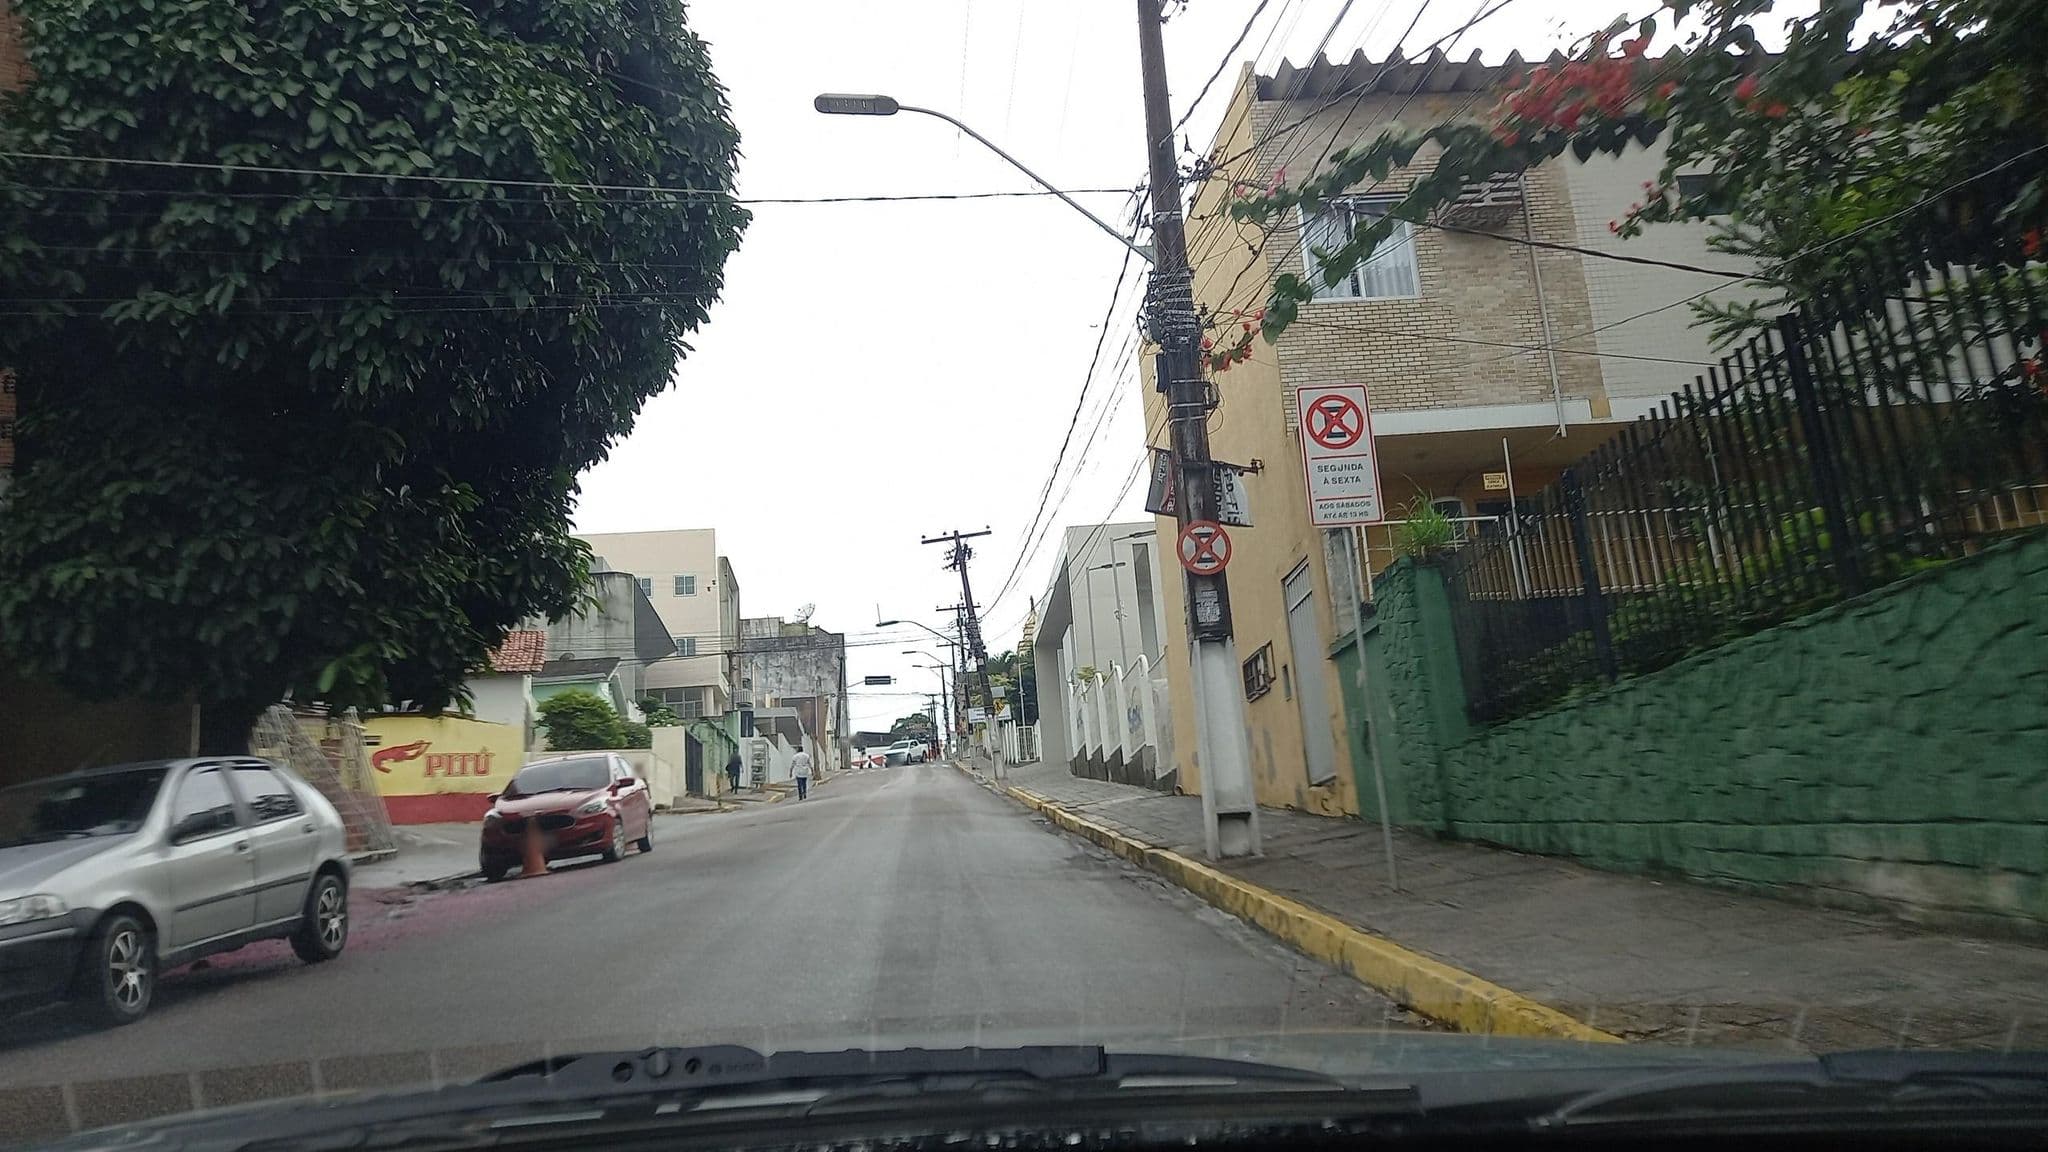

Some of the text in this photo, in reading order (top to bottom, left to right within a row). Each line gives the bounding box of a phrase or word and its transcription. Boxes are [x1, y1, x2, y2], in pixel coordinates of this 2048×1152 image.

[1318, 464, 1364, 472] SEGUNDA
[1332, 476, 1360, 484] SEXTA
[423, 745, 494, 778] PITÚ
